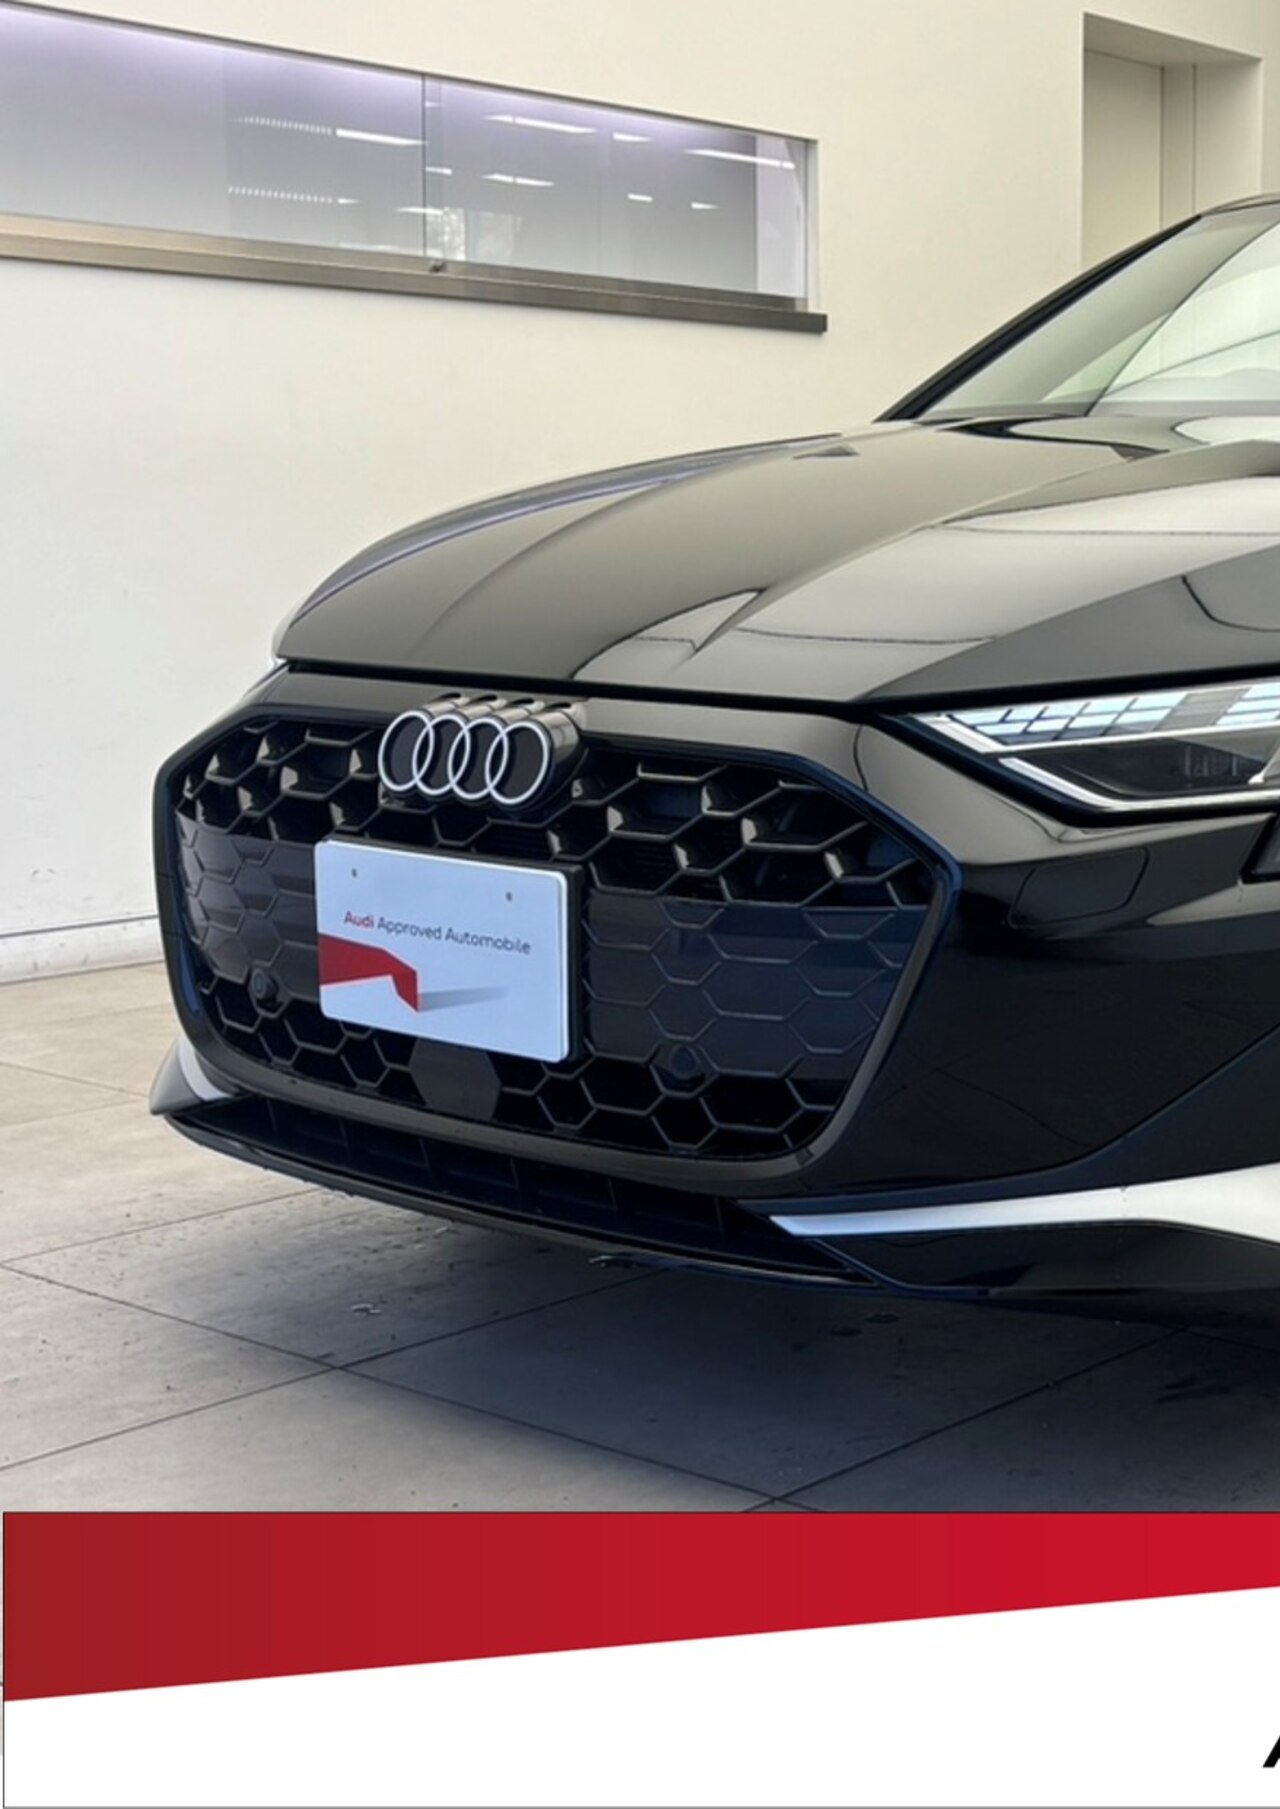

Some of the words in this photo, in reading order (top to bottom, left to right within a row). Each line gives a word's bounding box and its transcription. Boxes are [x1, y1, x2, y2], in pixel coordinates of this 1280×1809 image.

[344, 911, 375, 929] Audi
[377, 917, 443, 941] Approved
[445, 927, 532, 955] Automobile
